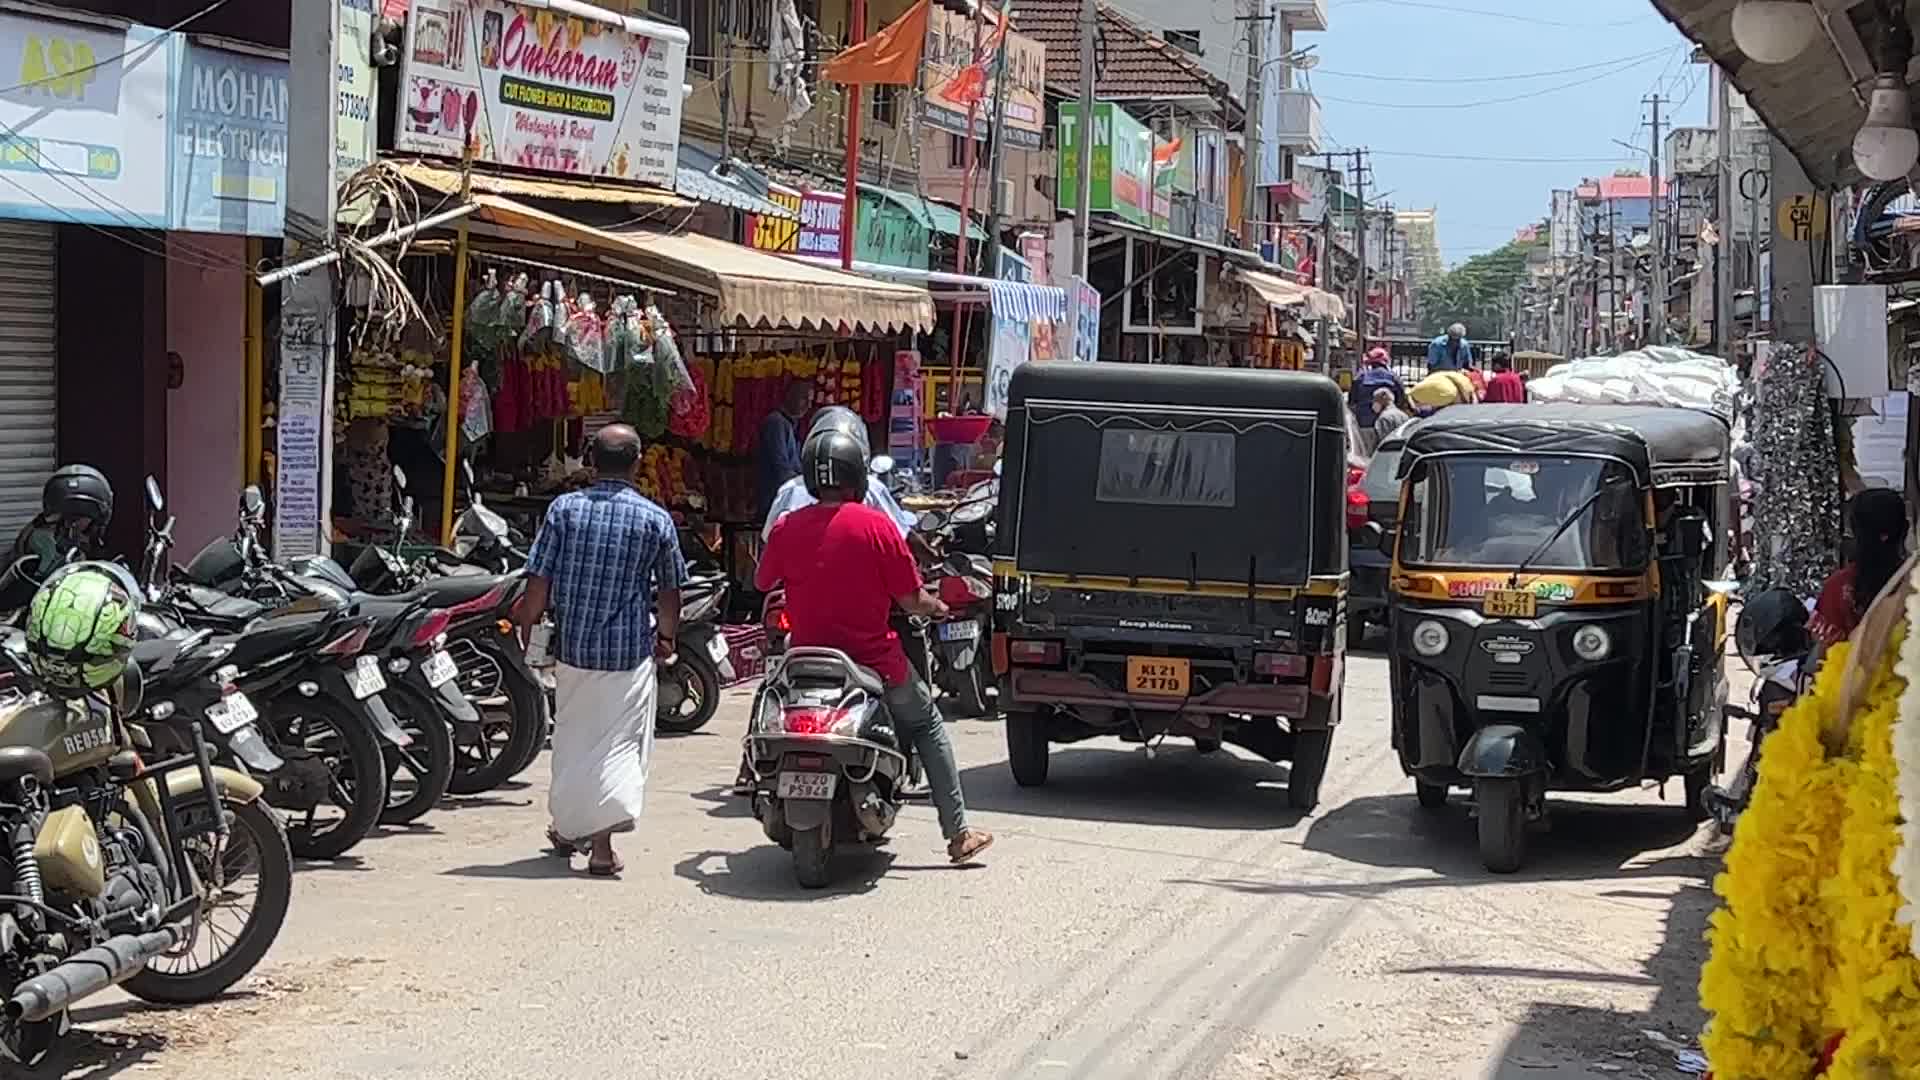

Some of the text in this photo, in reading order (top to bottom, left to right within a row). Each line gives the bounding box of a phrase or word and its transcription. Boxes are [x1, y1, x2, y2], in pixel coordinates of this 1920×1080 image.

[503, 14, 618, 91] Omkaram
[18, 32, 97, 100] ASP
[519, 86, 546, 105] FLOWER
[546, 90, 565, 107] SHOP
[571, 94, 612, 116] DECORATION
[1119, 619, 1147, 629] Keep
[1141, 663, 1175, 676] KL 21
[1136, 676, 1180, 691] 2179
[794, 775, 828, 785] KL 20
